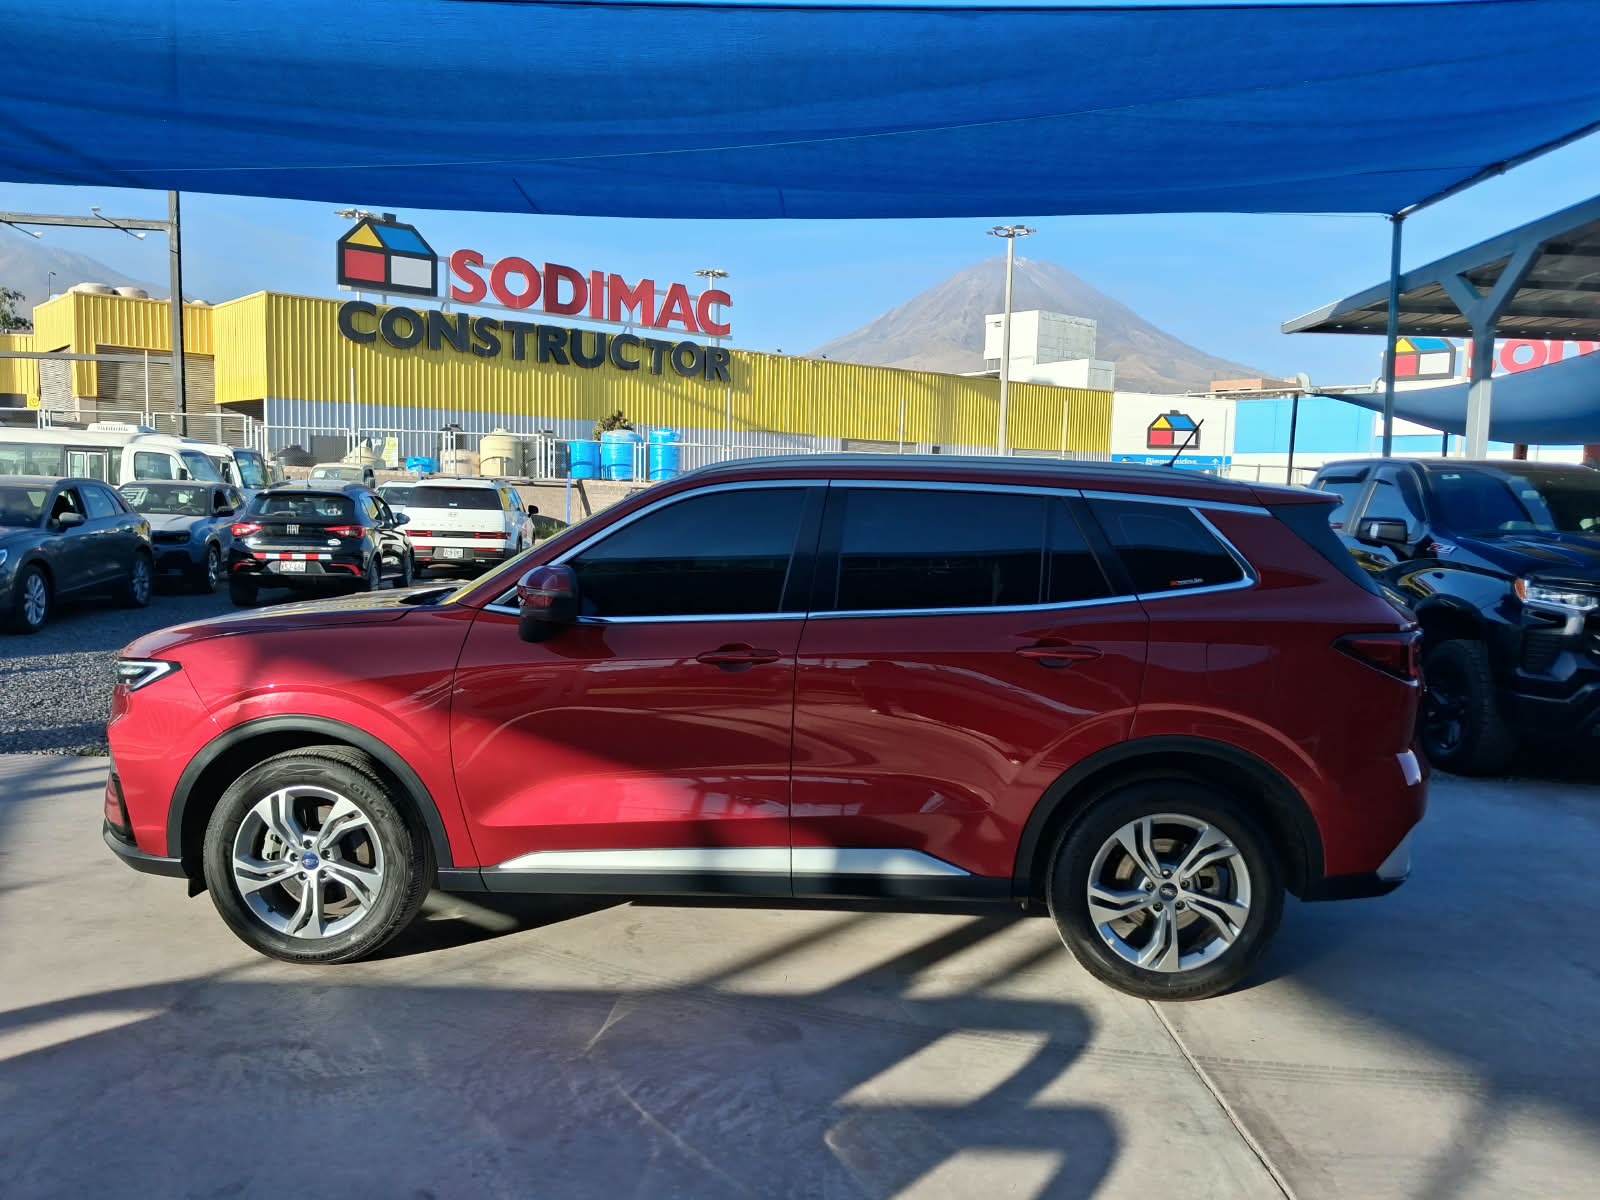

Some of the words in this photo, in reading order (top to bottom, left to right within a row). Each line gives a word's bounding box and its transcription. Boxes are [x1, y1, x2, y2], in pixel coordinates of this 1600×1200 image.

[450, 249, 732, 336] SODIMAC
[337, 300, 732, 383] CONSTRUCTOR
[286, 524, 300, 535] FIAT
